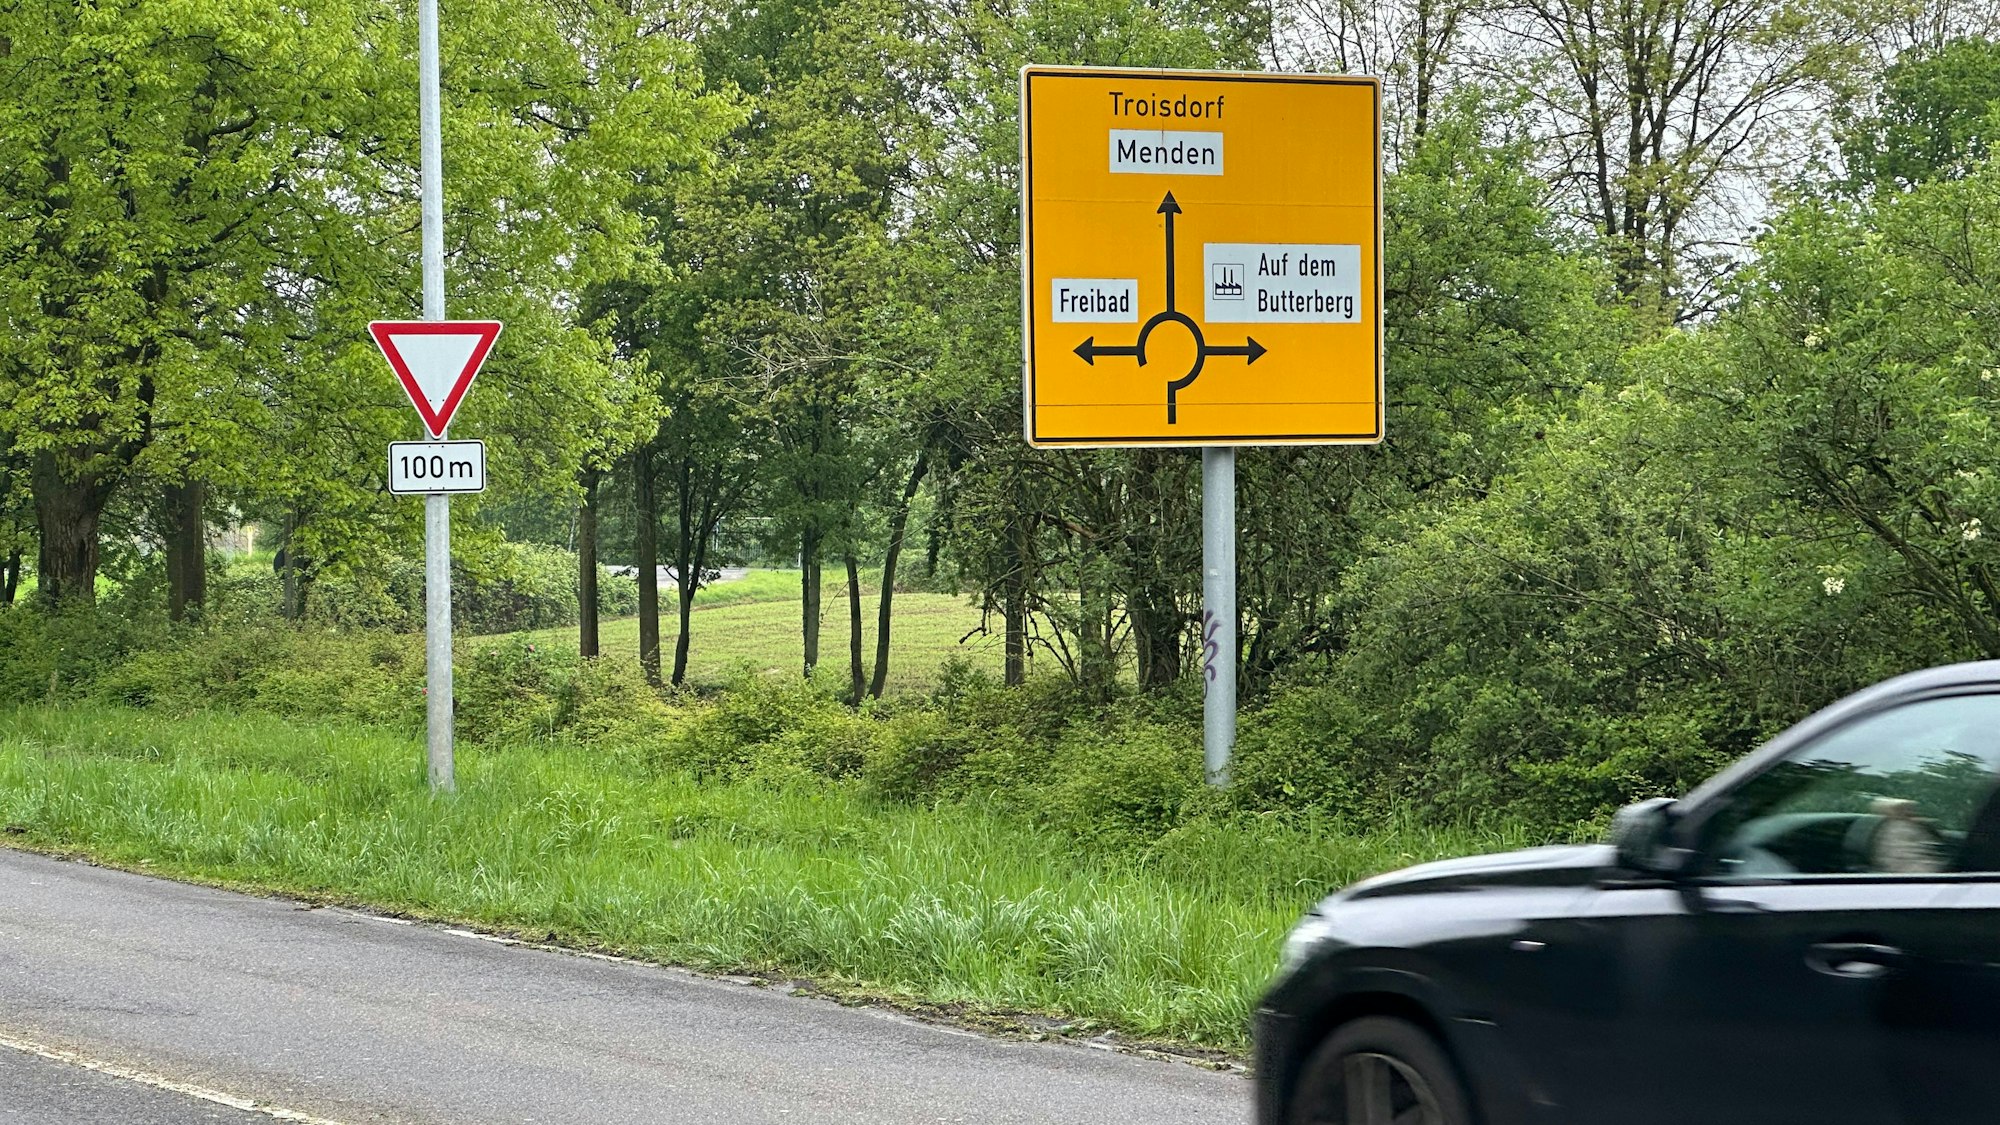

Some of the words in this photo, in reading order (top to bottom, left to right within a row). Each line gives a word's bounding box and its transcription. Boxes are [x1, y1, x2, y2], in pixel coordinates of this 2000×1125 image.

[1109, 92, 1224, 118] Troisdorf
[1118, 139, 1214, 164] Menden
[1259, 253, 1288, 276] Auf
[1300, 253, 1335, 276] dem
[1061, 289, 1128, 312] Freibad
[1259, 289, 1352, 318] Butterberg
